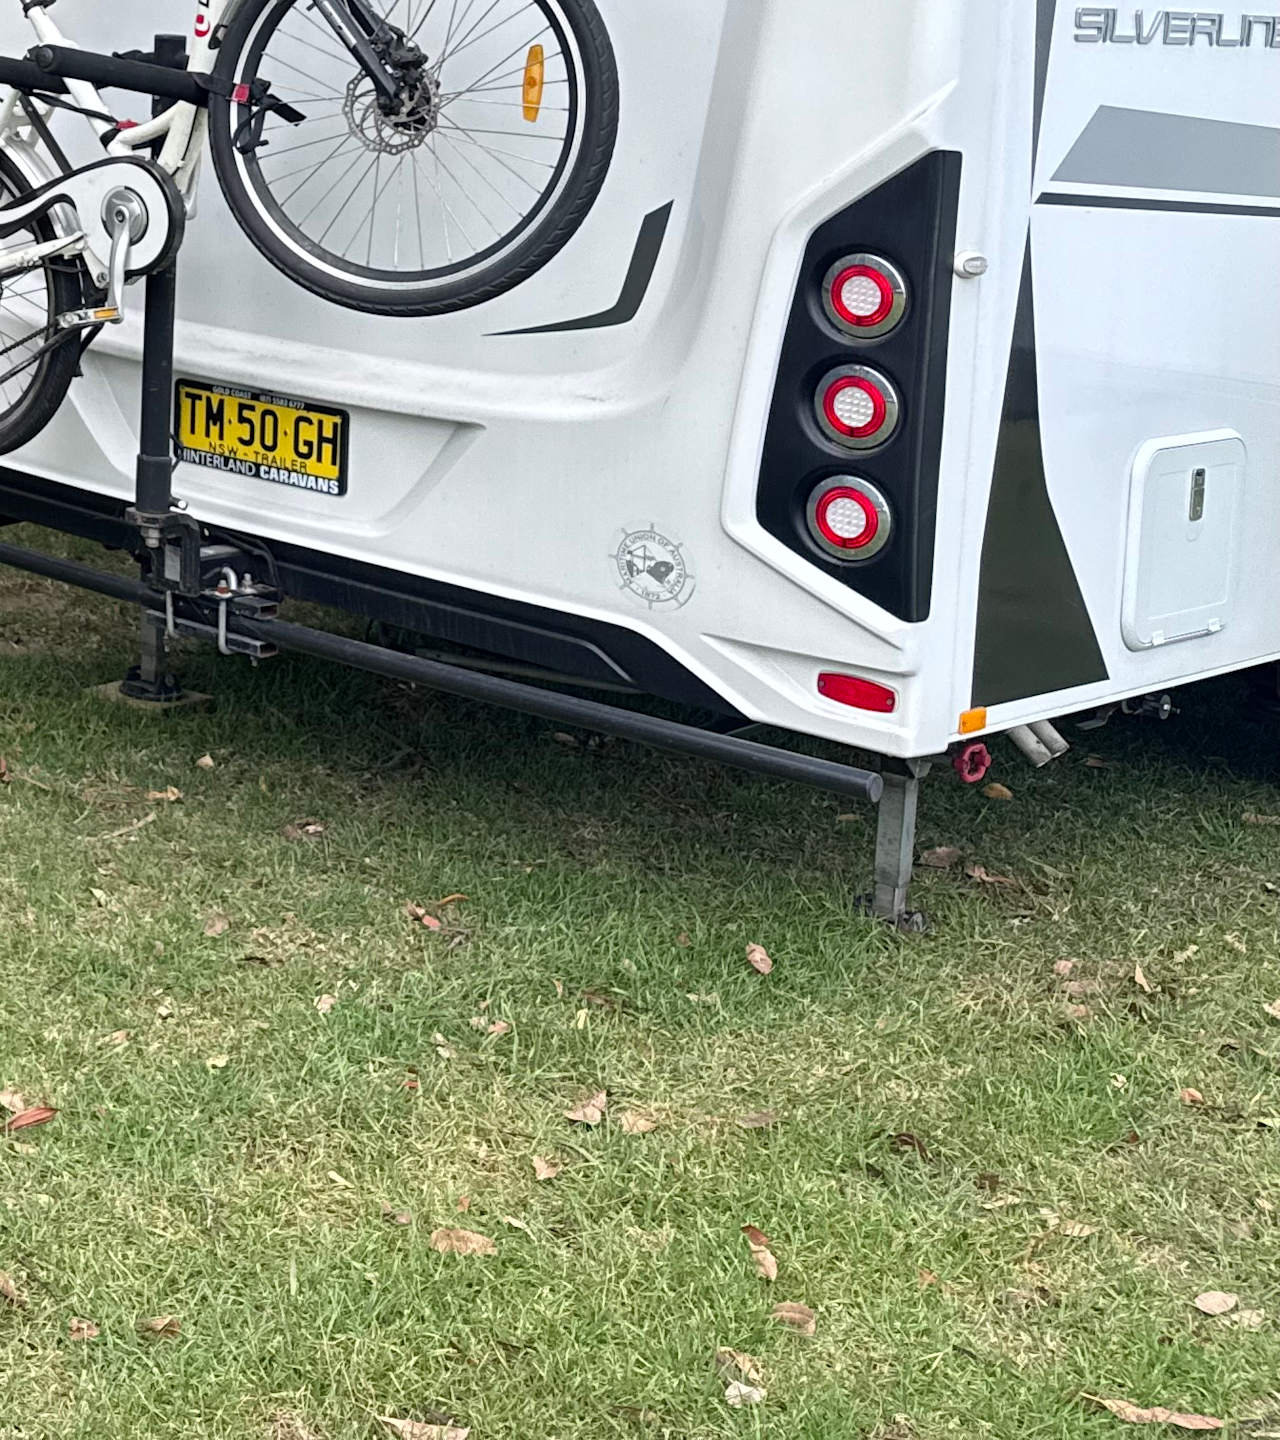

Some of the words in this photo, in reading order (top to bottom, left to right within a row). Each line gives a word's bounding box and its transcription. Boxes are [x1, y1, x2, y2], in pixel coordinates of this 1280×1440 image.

[208, 441, 238, 458] NSW
[253, 450, 308, 474] TRAILER
[259, 465, 339, 495] CARAVANS
